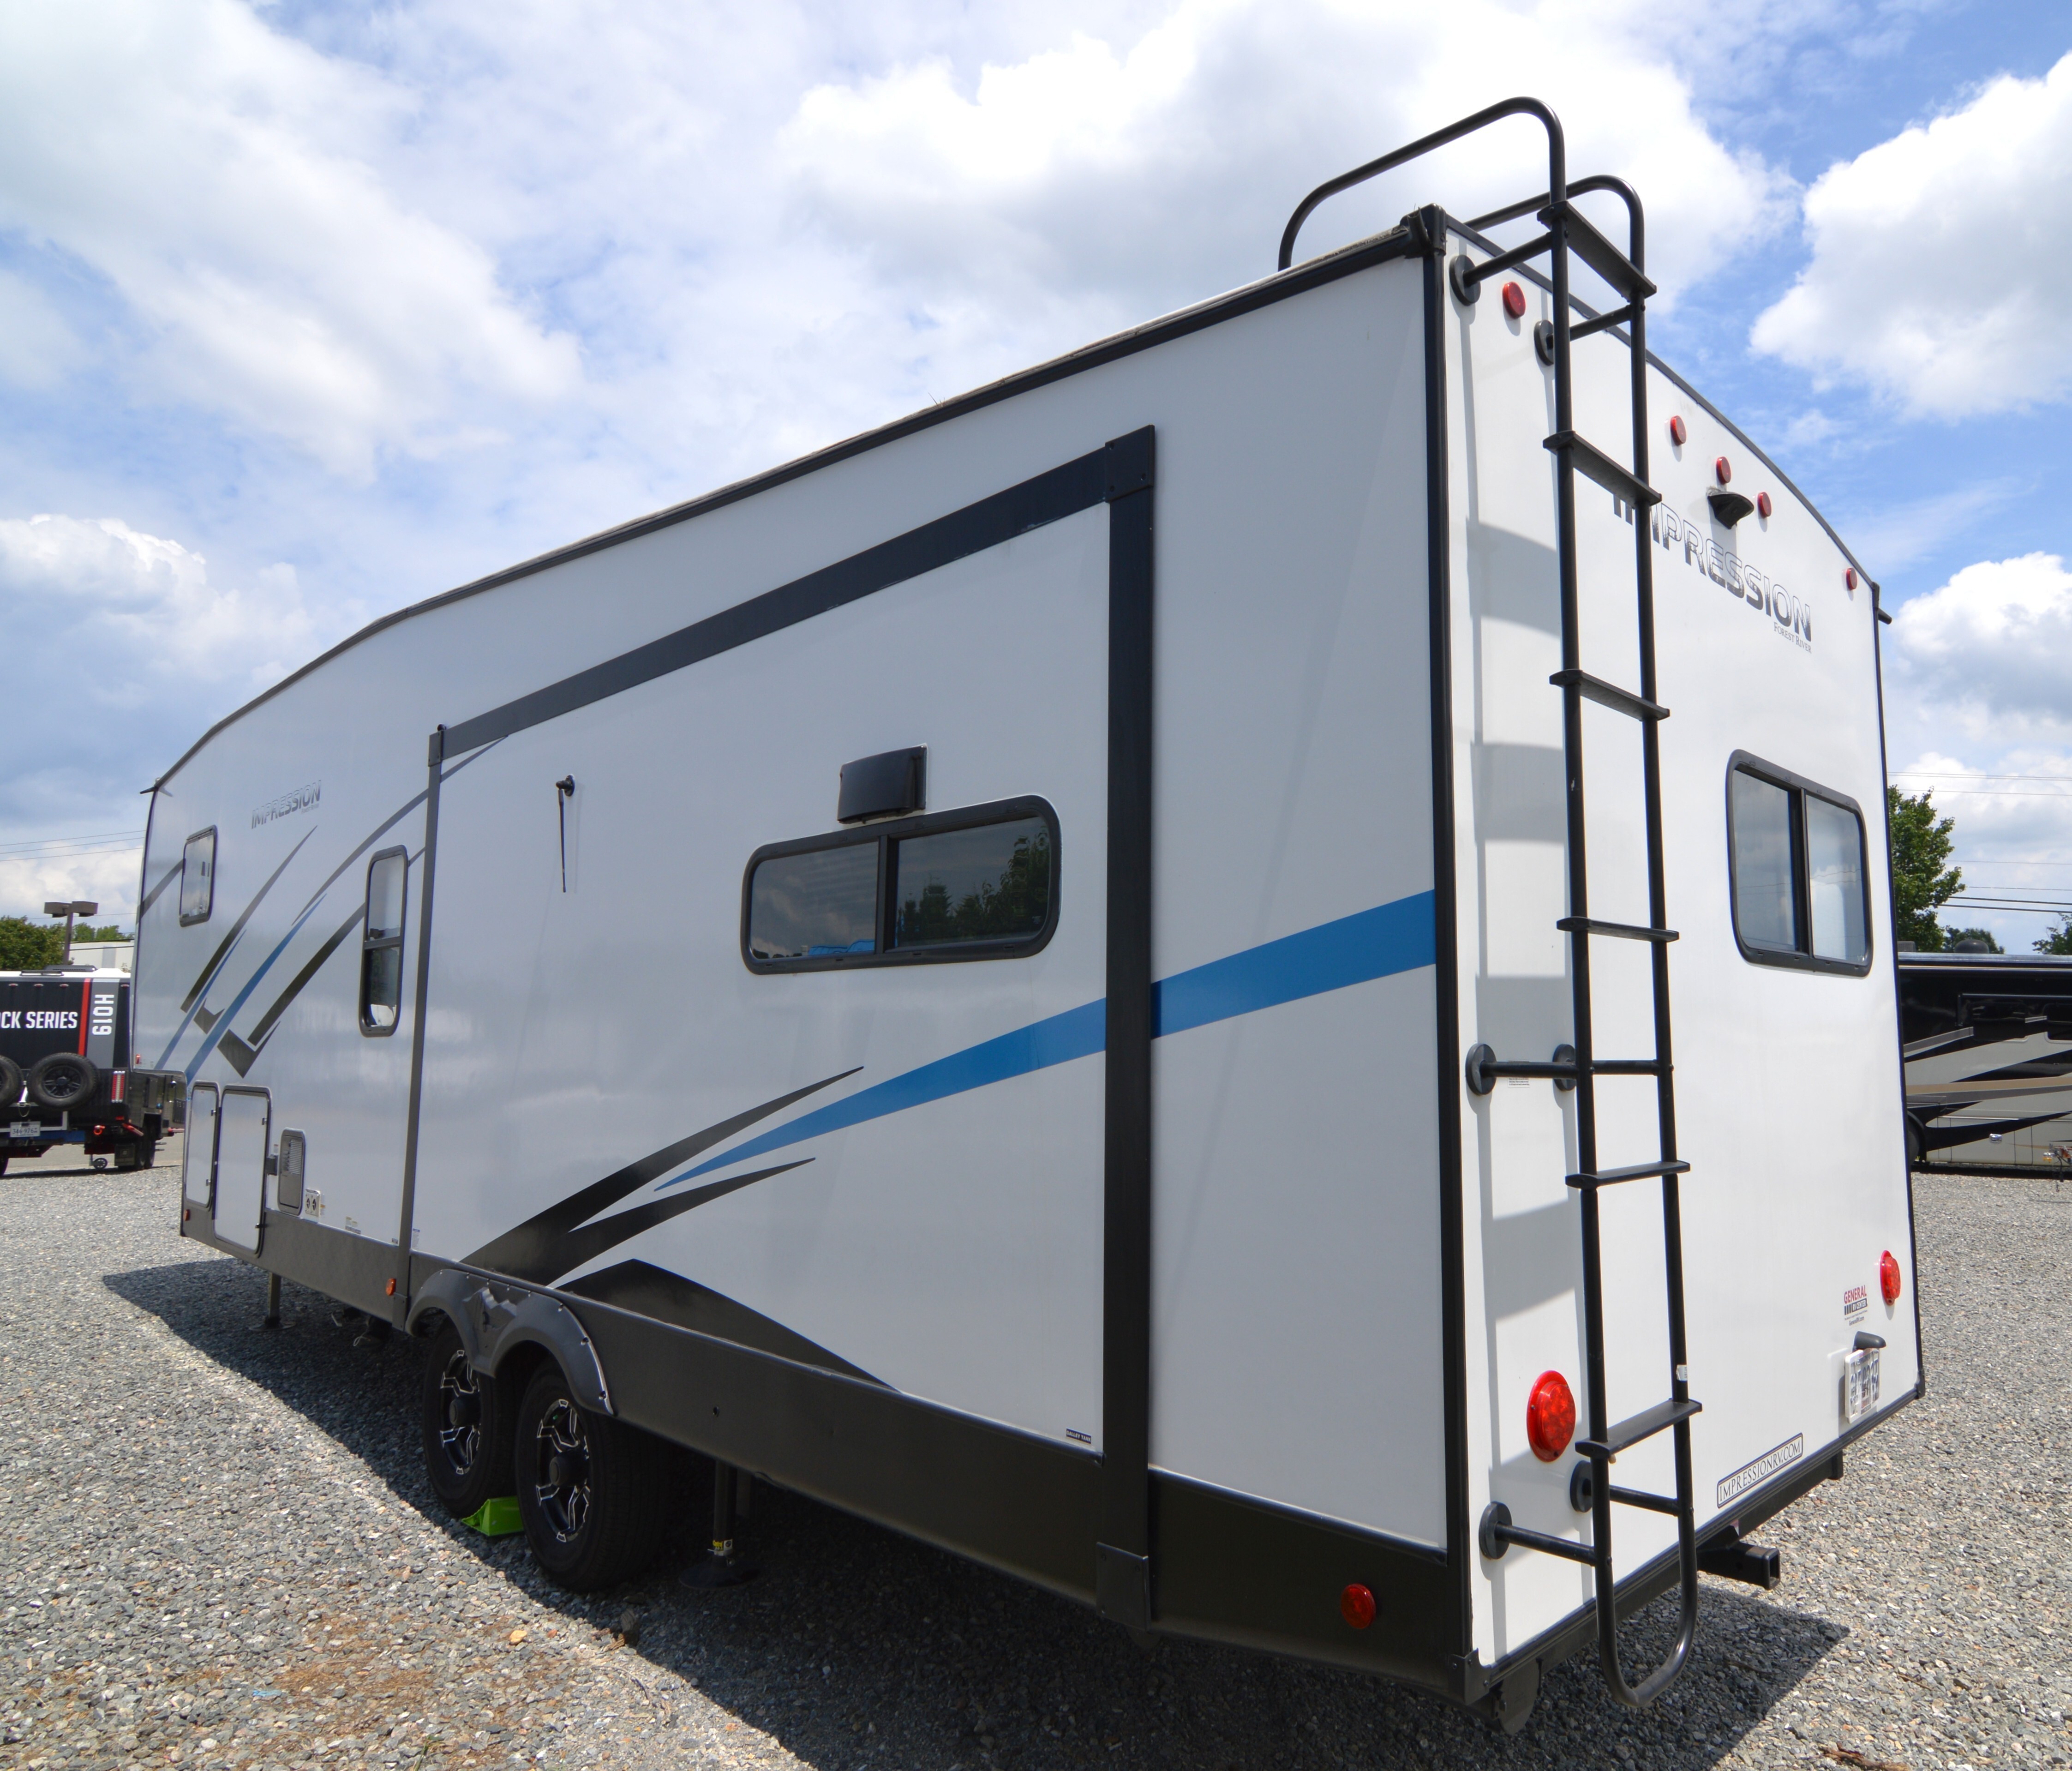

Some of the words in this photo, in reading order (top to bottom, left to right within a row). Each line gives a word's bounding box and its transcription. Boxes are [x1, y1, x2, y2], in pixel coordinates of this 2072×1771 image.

[1774, 621, 1794, 642] FOREST
[1796, 635, 1812, 654] RIVER
[252, 780, 321, 829] IMPRESSION
[0, 1011, 22, 1028] CK
[25, 1011, 78, 1028] SERIES
[92, 994, 114, 1035] HQ19
[1844, 1285, 1867, 1304] GENERAL
[1720, 1440, 1800, 1501] IMPRESSIONRV.COM
